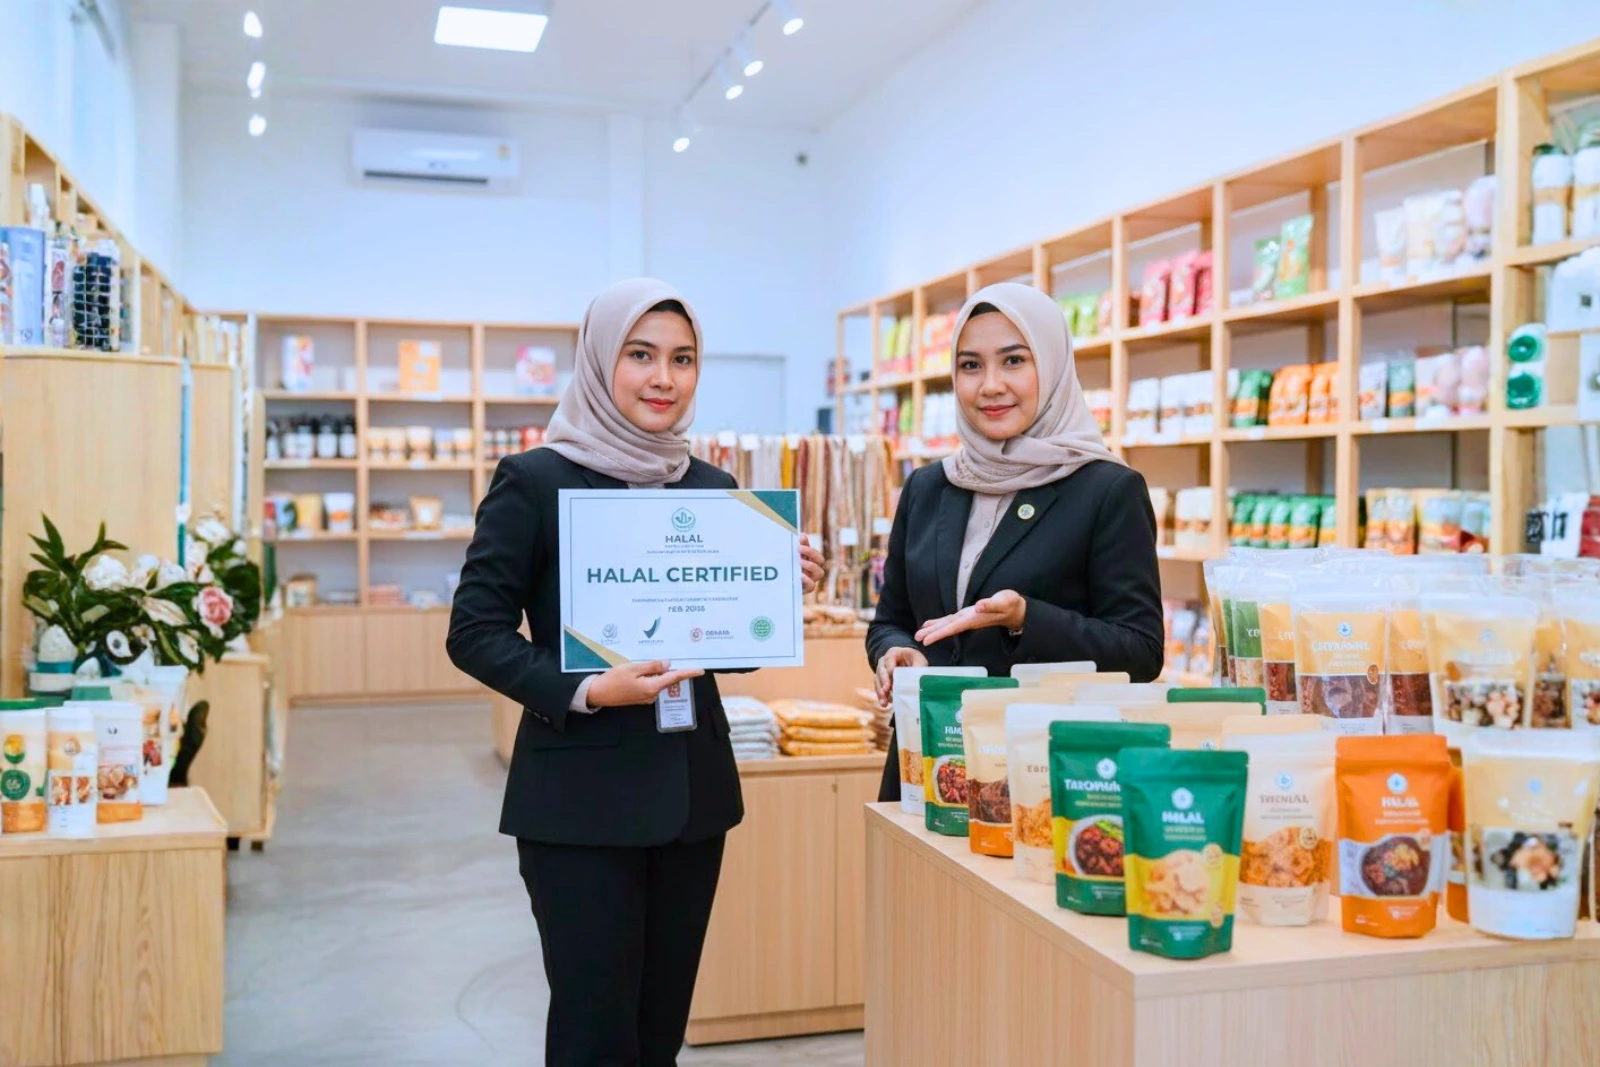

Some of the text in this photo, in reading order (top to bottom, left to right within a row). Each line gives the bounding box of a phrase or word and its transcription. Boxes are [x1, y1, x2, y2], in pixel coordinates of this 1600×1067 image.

[665, 534, 703, 543] HALAL
[587, 566, 778, 583] HALAL CERTIFIED
